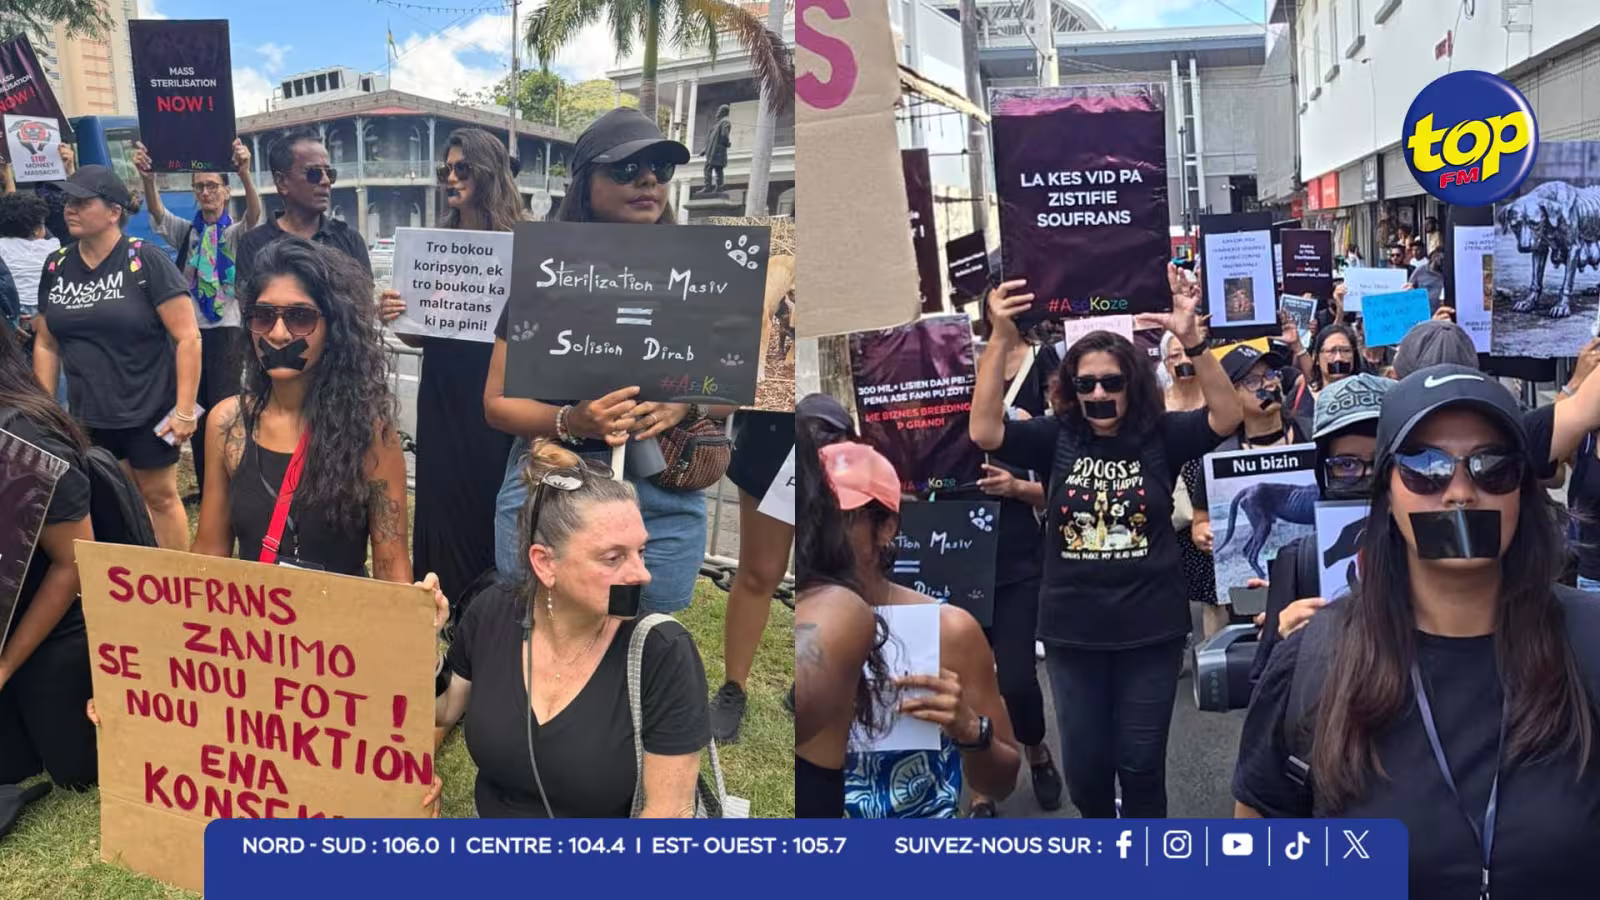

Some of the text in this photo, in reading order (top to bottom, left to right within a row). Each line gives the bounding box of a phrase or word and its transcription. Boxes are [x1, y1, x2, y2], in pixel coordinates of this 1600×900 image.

[169, 67, 195, 76] MASS
[150, 78, 217, 88] STERILISATION
[156, 96, 215, 113] NOW !
[1020, 169, 1144, 188] LA KES VID PA
[1048, 191, 1118, 207] ZISTIFIE
[1037, 210, 1132, 228] SOUFRANS
[427, 241, 494, 256] Tro bokou
[414, 260, 504, 277] koripsyon, ek
[51, 271, 123, 296] ANSAM
[412, 279, 506, 296] tro boukou ka
[536, 258, 728, 301] Sterilization Masiv
[103, 289, 125, 300] ZIL
[419, 298, 492, 314] maltratans
[424, 315, 487, 332] ki pa pini!
[549, 330, 695, 361] Solision Dirab
[1081, 457, 1128, 479] DOGS
[1233, 454, 1299, 473] Nu bizin
[1094, 479, 1109, 491] ME
[930, 530, 972, 555] Masiv
[107, 566, 297, 625] SOUFRANS
[182, 622, 356, 678] ZANIMO
[98, 643, 142, 680] SE
[169, 656, 246, 700] NOU
[274, 677, 368, 728] FOT
[126, 688, 433, 786] NOU INAKTION
[200, 744, 288, 795] ENA
